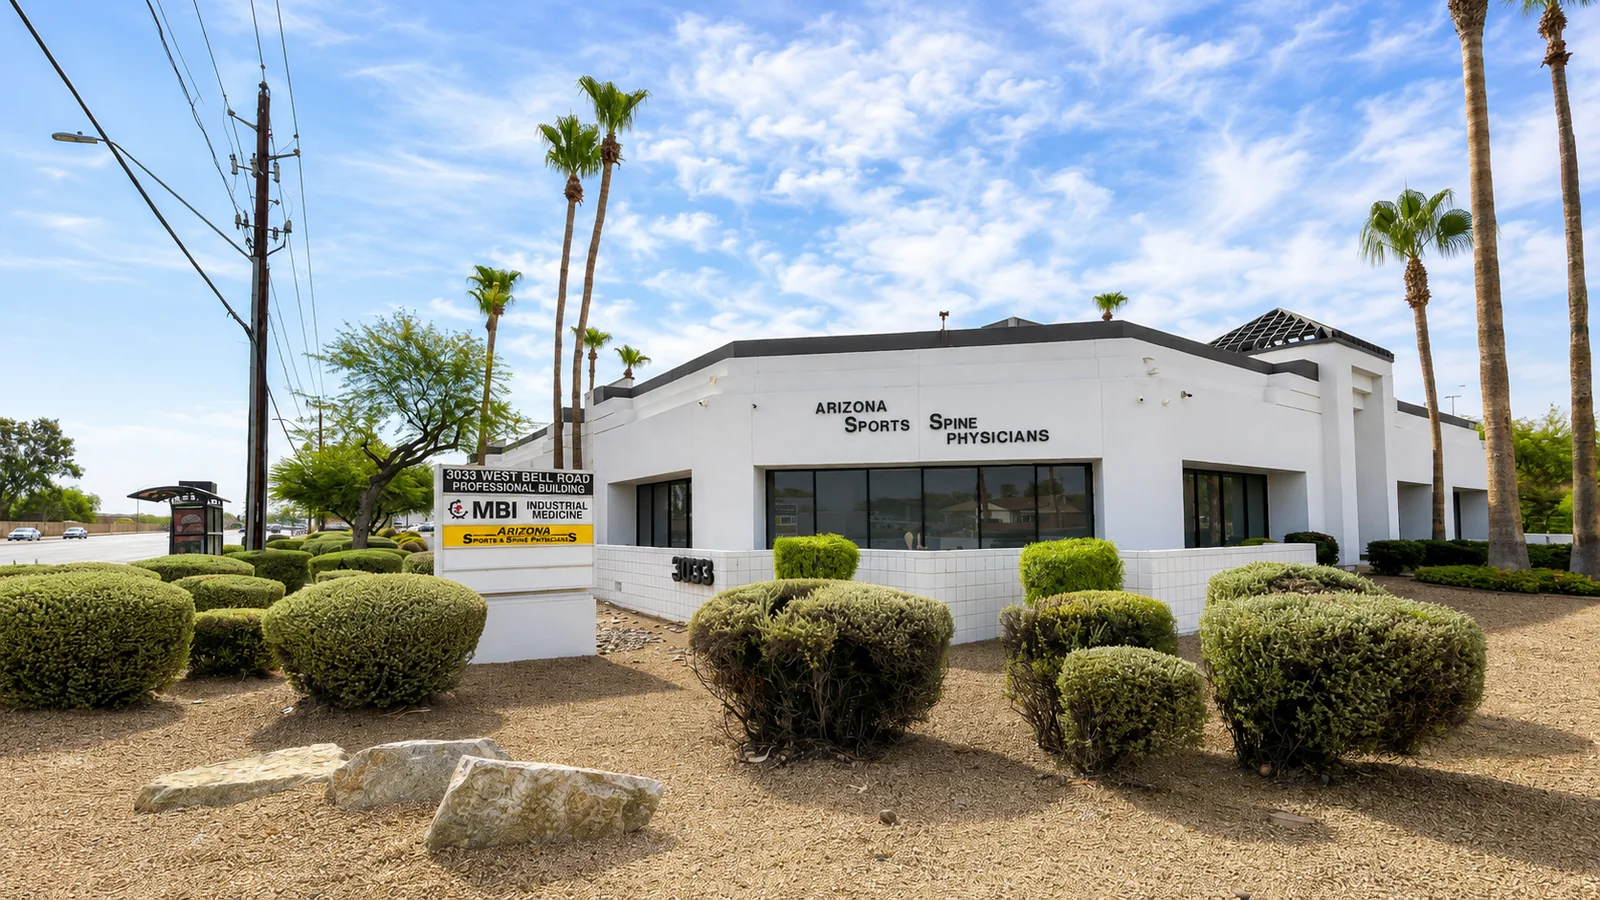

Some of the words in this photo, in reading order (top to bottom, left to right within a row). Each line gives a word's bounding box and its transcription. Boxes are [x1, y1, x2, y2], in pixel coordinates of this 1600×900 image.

[815, 400, 887, 414] ARIZONA
[844, 416, 910, 433] SPORTS
[929, 413, 978, 430] SPINE
[946, 429, 1050, 445] PHYSICIANS
[446, 470, 476, 480] 3033
[481, 471, 518, 482] WEST
[522, 472, 554, 483] BELL
[557, 474, 590, 484] ROAD
[452, 482, 535, 492] PROFESSIONAL
[538, 484, 585, 494] BUILDING
[472, 501, 517, 519] MBI
[526, 501, 588, 510] INDUSTRIAL
[532, 510, 582, 520] MEDICINE
[497, 526, 550, 536] ARIZONA
[463, 534, 497, 544] SPORTS
[671, 556, 714, 586] 3033
